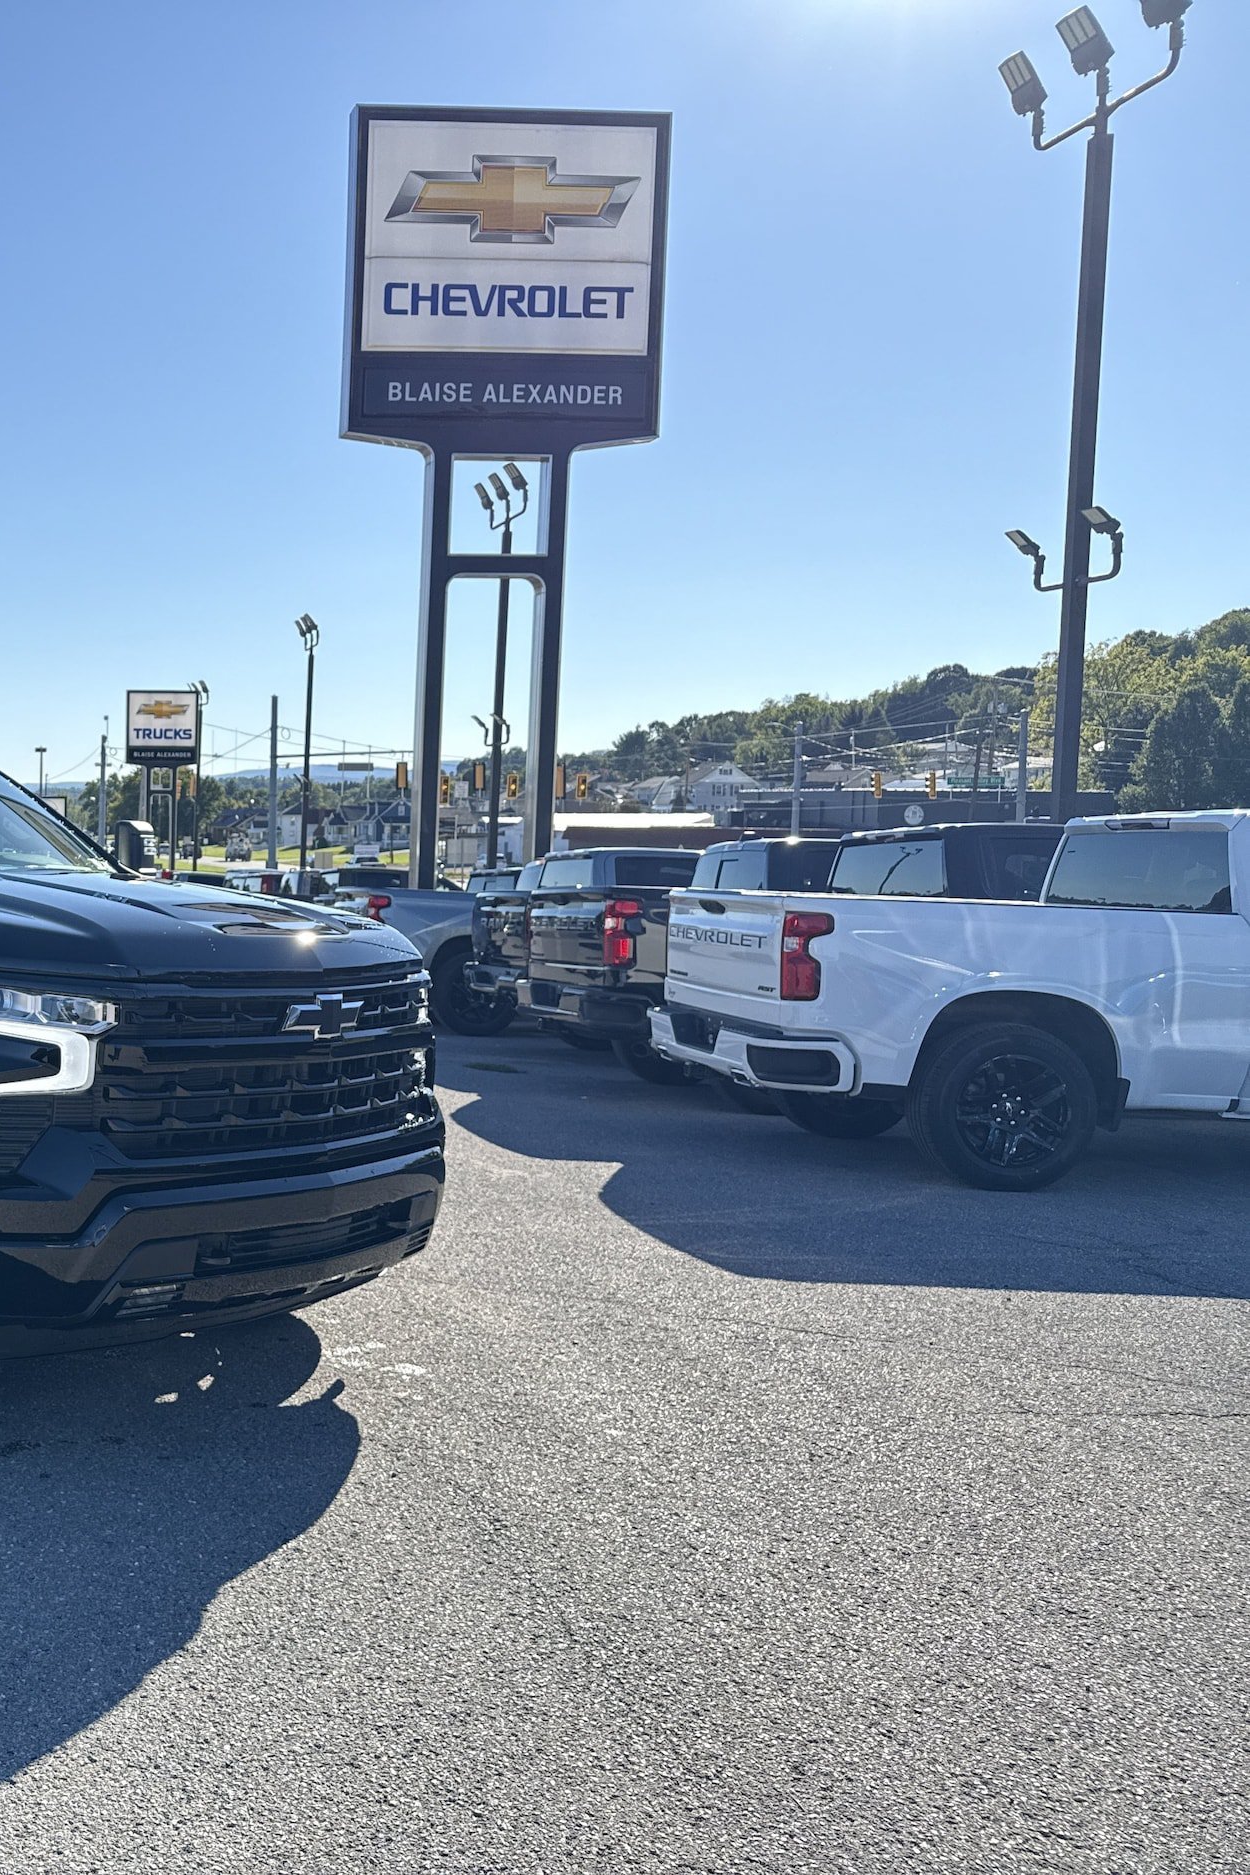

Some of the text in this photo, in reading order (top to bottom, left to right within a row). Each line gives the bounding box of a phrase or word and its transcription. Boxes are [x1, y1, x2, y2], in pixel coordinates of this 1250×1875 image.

[383, 282, 635, 319] CHEVROLET
[388, 382, 623, 405] BLAISE ALEXANDER
[133, 728, 192, 740] TRUCKS
[481, 917, 504, 929] RAM
[670, 925, 768, 949] CHEVROLET
